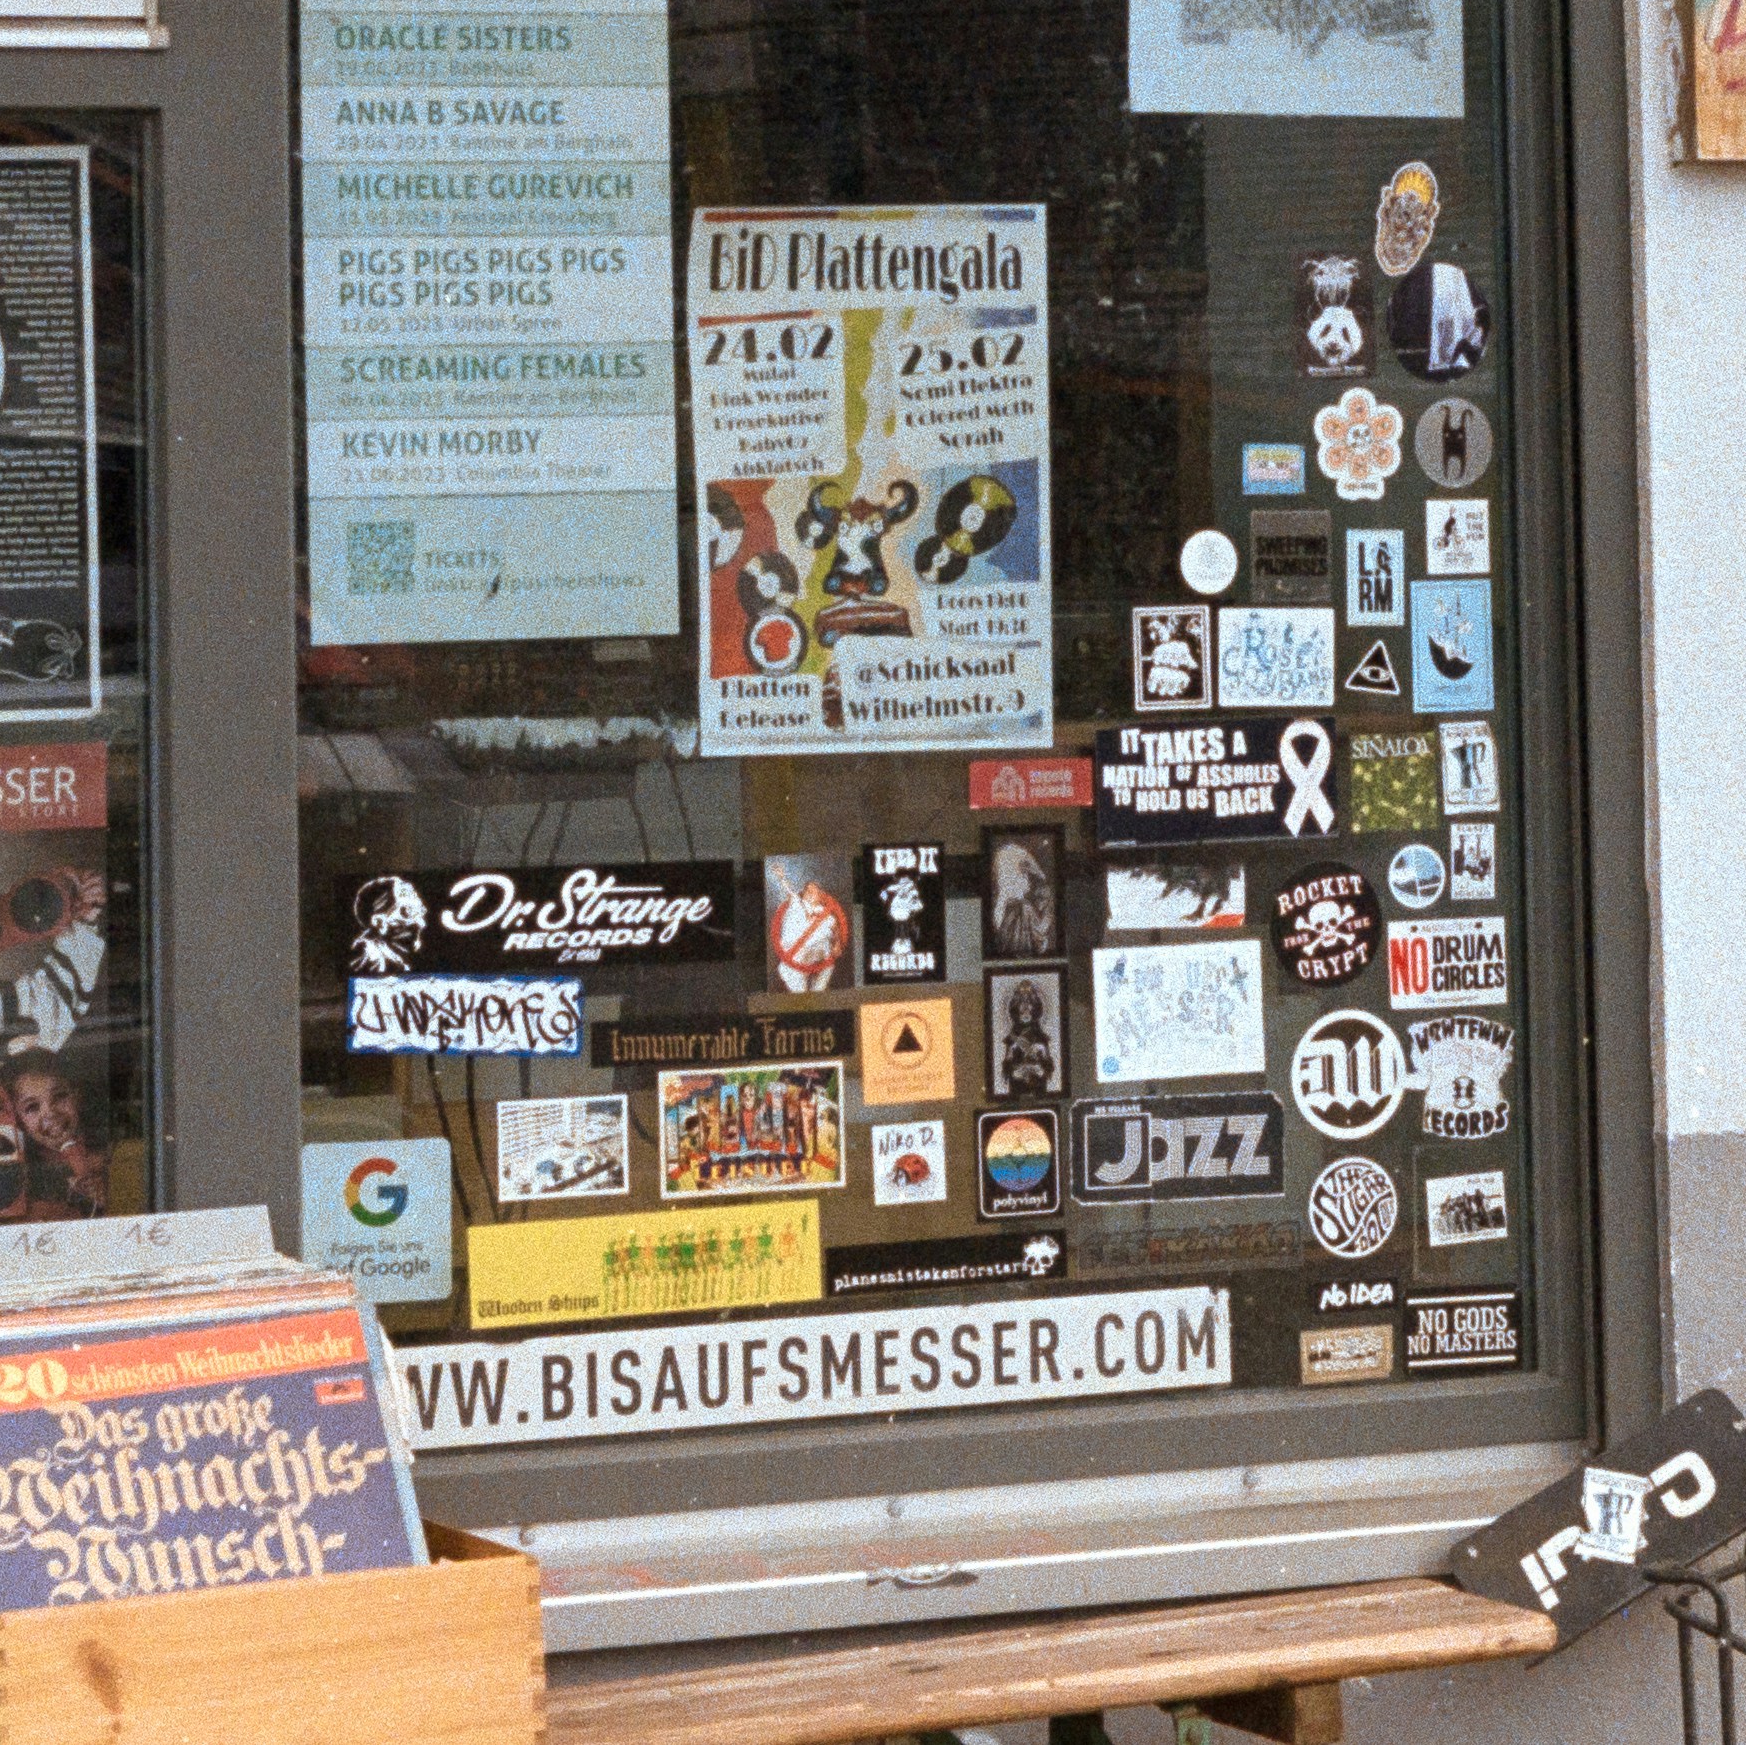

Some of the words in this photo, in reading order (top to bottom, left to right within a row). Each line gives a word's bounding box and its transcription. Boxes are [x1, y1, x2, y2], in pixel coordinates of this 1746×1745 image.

[334, 24, 448, 53] ORACLE
[455, 25, 573, 54] SISTERS
[335, 100, 418, 127] ANNA
[427, 100, 446, 127] B
[454, 100, 565, 127] SAVAGE
[337, 174, 480, 201] MICHELLE
[486, 173, 635, 201] GUREVICH
[338, 249, 406, 276] PIGS
[413, 249, 480, 276] PIGS
[487, 247, 554, 274] PIGS
[561, 246, 626, 273] PIGS
[786, 230, 1026, 304] Plattengala
[339, 280, 406, 307] PIGS
[413, 280, 480, 306] PIGS
[488, 280, 554, 306] PIGS
[703, 323, 835, 367] 24.02
[898, 331, 1027, 377] 25.02
[340, 353, 512, 384] SCREAMING
[519, 352, 648, 381] FEMALES
[341, 431, 430, 459] KEVIN
[438, 429, 542, 456] MORBY
[1120, 727, 1141, 755] IT
[1140, 726, 1227, 766] TAKES
[1231, 729, 1249, 756] A
[1351, 734, 1436, 761] SINALOA
[1101, 764, 1171, 789] NATION
[1196, 762, 1282, 786] ASSHOLES
[1112, 788, 1131, 807] TO
[1134, 788, 1182, 814] HOLD
[1184, 786, 1209, 810] US
[1213, 786, 1277, 819] BACK
[439, 871, 538, 935] Dr.
[534, 867, 715, 947] Strange
[1275, 872, 1365, 917] ROCKET
[502, 926, 655, 953] RECORDS
[1431, 931, 1504, 964] DRUM
[1296, 940, 1370, 981] CRYPT
[1388, 935, 1431, 997] NO
[1431, 962, 1506, 995] CIRCLES
[1093, 1111, 1274, 1187] Jazz
[343, 1156, 410, 1229] G
[358, 1256, 432, 1282] Google
[1417, 1306, 1449, 1335] NO
[1453, 1304, 1510, 1334] GODS
[1406, 1335, 1432, 1357] NO
[1434, 1328, 1519, 1356] MASTERS
[69, 1357, 178, 1400] schönsten
[174, 1329, 356, 1380] Weihnachtslieder
[53, 1400, 150, 1453] Das
[155, 1384, 275, 1454] große
[31, 1506, 347, 1606] Wunsch-
